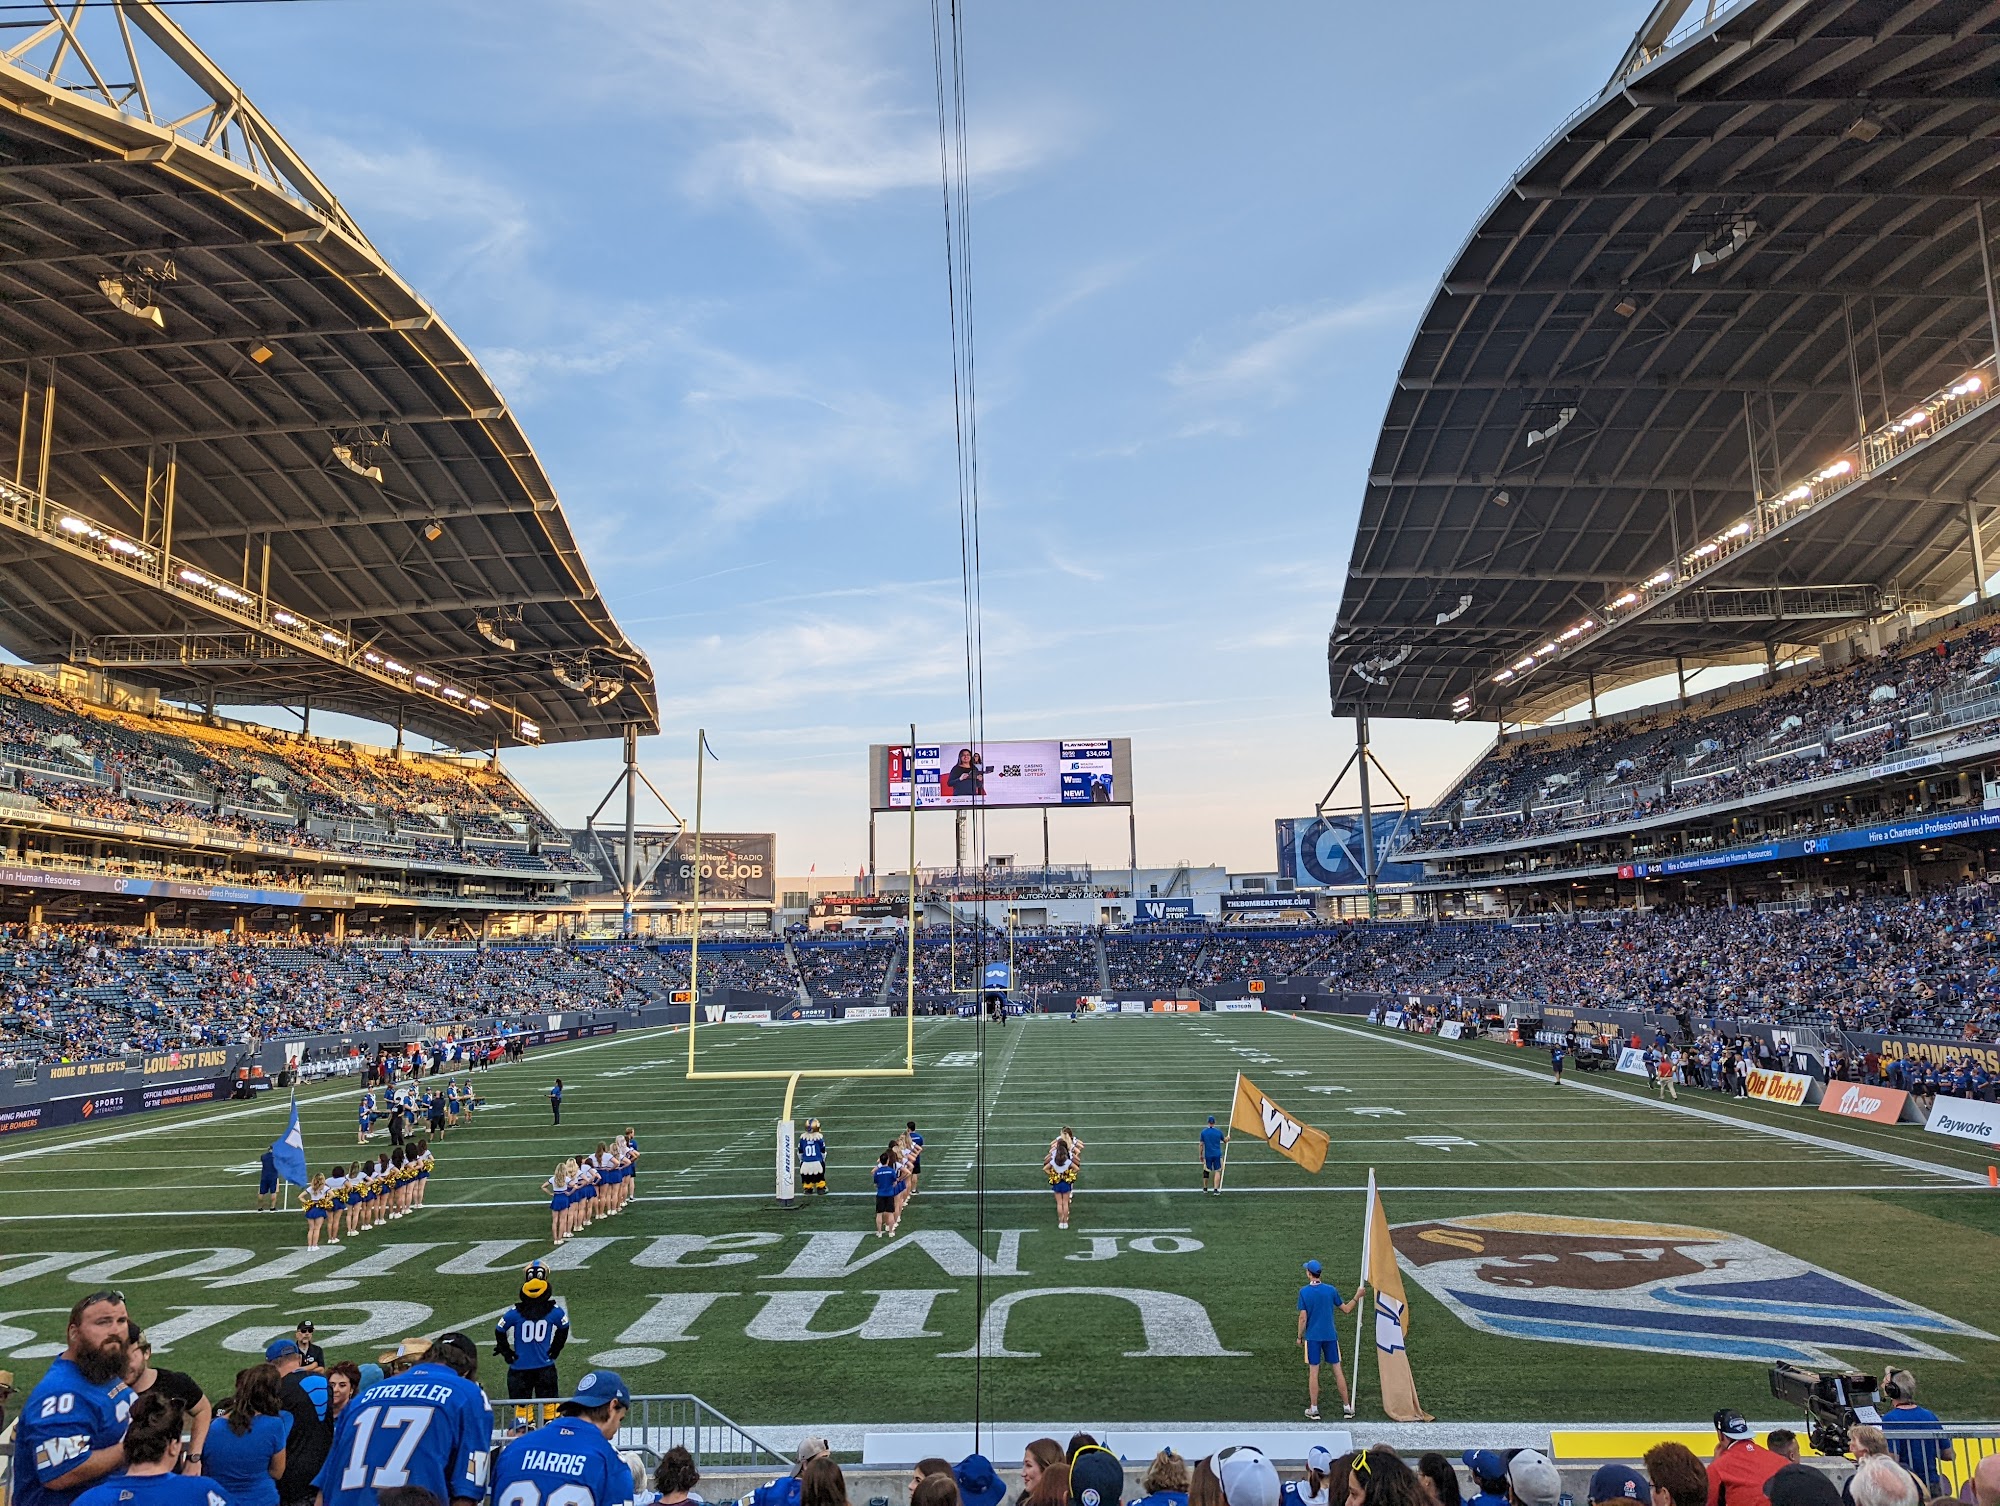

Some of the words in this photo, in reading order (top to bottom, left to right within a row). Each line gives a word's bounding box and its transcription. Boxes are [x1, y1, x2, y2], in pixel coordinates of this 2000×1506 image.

[12, 810, 36, 819] HONOUR
[1869, 831, 1883, 842] Hire
[1890, 826, 1923, 839] Chartered
[1925, 818, 1970, 834] Professional
[1971, 816, 1979, 826] in
[1803, 839, 1829, 853] CPHR
[1668, 862, 1676, 870] Hire
[1680, 858, 1699, 869] Chartered
[1700, 854, 1725, 867] Professional
[1731, 852, 1747, 862] Human
[1748, 849, 1772, 860] Resources
[680, 864, 713, 879] 680
[716, 864, 763, 879] CJOB
[992, 866, 1011, 876] CUP
[1014, 865, 1066, 876] CHAMPONS
[1648, 865, 1662, 873] 14:31
[6, 873, 14, 881] in
[15, 873, 43, 884] Human
[45, 875, 81, 886] Resources
[114, 879, 129, 892] CP
[179, 886, 190, 895] Hire
[197, 887, 223, 898] Chartered
[1355, 887, 1397, 895] RESURANT
[895, 896, 909, 904] DEC
[1226, 898, 1310, 908] THEBOMBERSTORE.COM
[1145, 902, 1166, 919] W
[705, 1005, 725, 1022] W
[548, 1015, 562, 1030] W
[198, 1050, 227, 1067] FANS
[1882, 1040, 1903, 1060] GO
[1622, 1052, 1634, 1069] IG
[1796, 1053, 1807, 1071] W
[50, 1066, 76, 1079] HOME
[77, 1065, 88, 1075] OF
[89, 1063, 105, 1074] THE
[106, 1061, 126, 1072] CFL'S
[143, 1090, 162, 1099] OFFICIAL
[163, 1088, 179, 1097] ONLINE
[179, 1086, 196, 1095] GAMING
[196, 1082, 215, 1094] PARTNER
[236, 1080, 244, 1089] G
[1748, 1071, 1765, 1094] Old
[1767, 1073, 1803, 1104] Dutch
[95, 1097, 123, 1107] SPORTS
[144, 1100, 151, 1108] OF
[151, 1099, 161, 1107] THE
[182, 1094, 193, 1103] BLUE
[193, 1091, 213, 1102] BOMBERS
[1855, 1096, 1882, 1115] SKIP
[15, 1108, 41, 1119] PARTNER
[94, 1105, 124, 1115] INTERACTION
[10, 1119, 38, 1130] BOMBERS
[1261, 1097, 1302, 1150] W
[1937, 1114, 1993, 1137] Payworks
[805, 1144, 817, 1157] 01
[521, 1319, 548, 1343] 00
[361, 1384, 452, 1405] STREVELER
[41, 1392, 75, 1419] 20
[340, 1405, 435, 1491] 17
[521, 1450, 586, 1476] HARRIS
